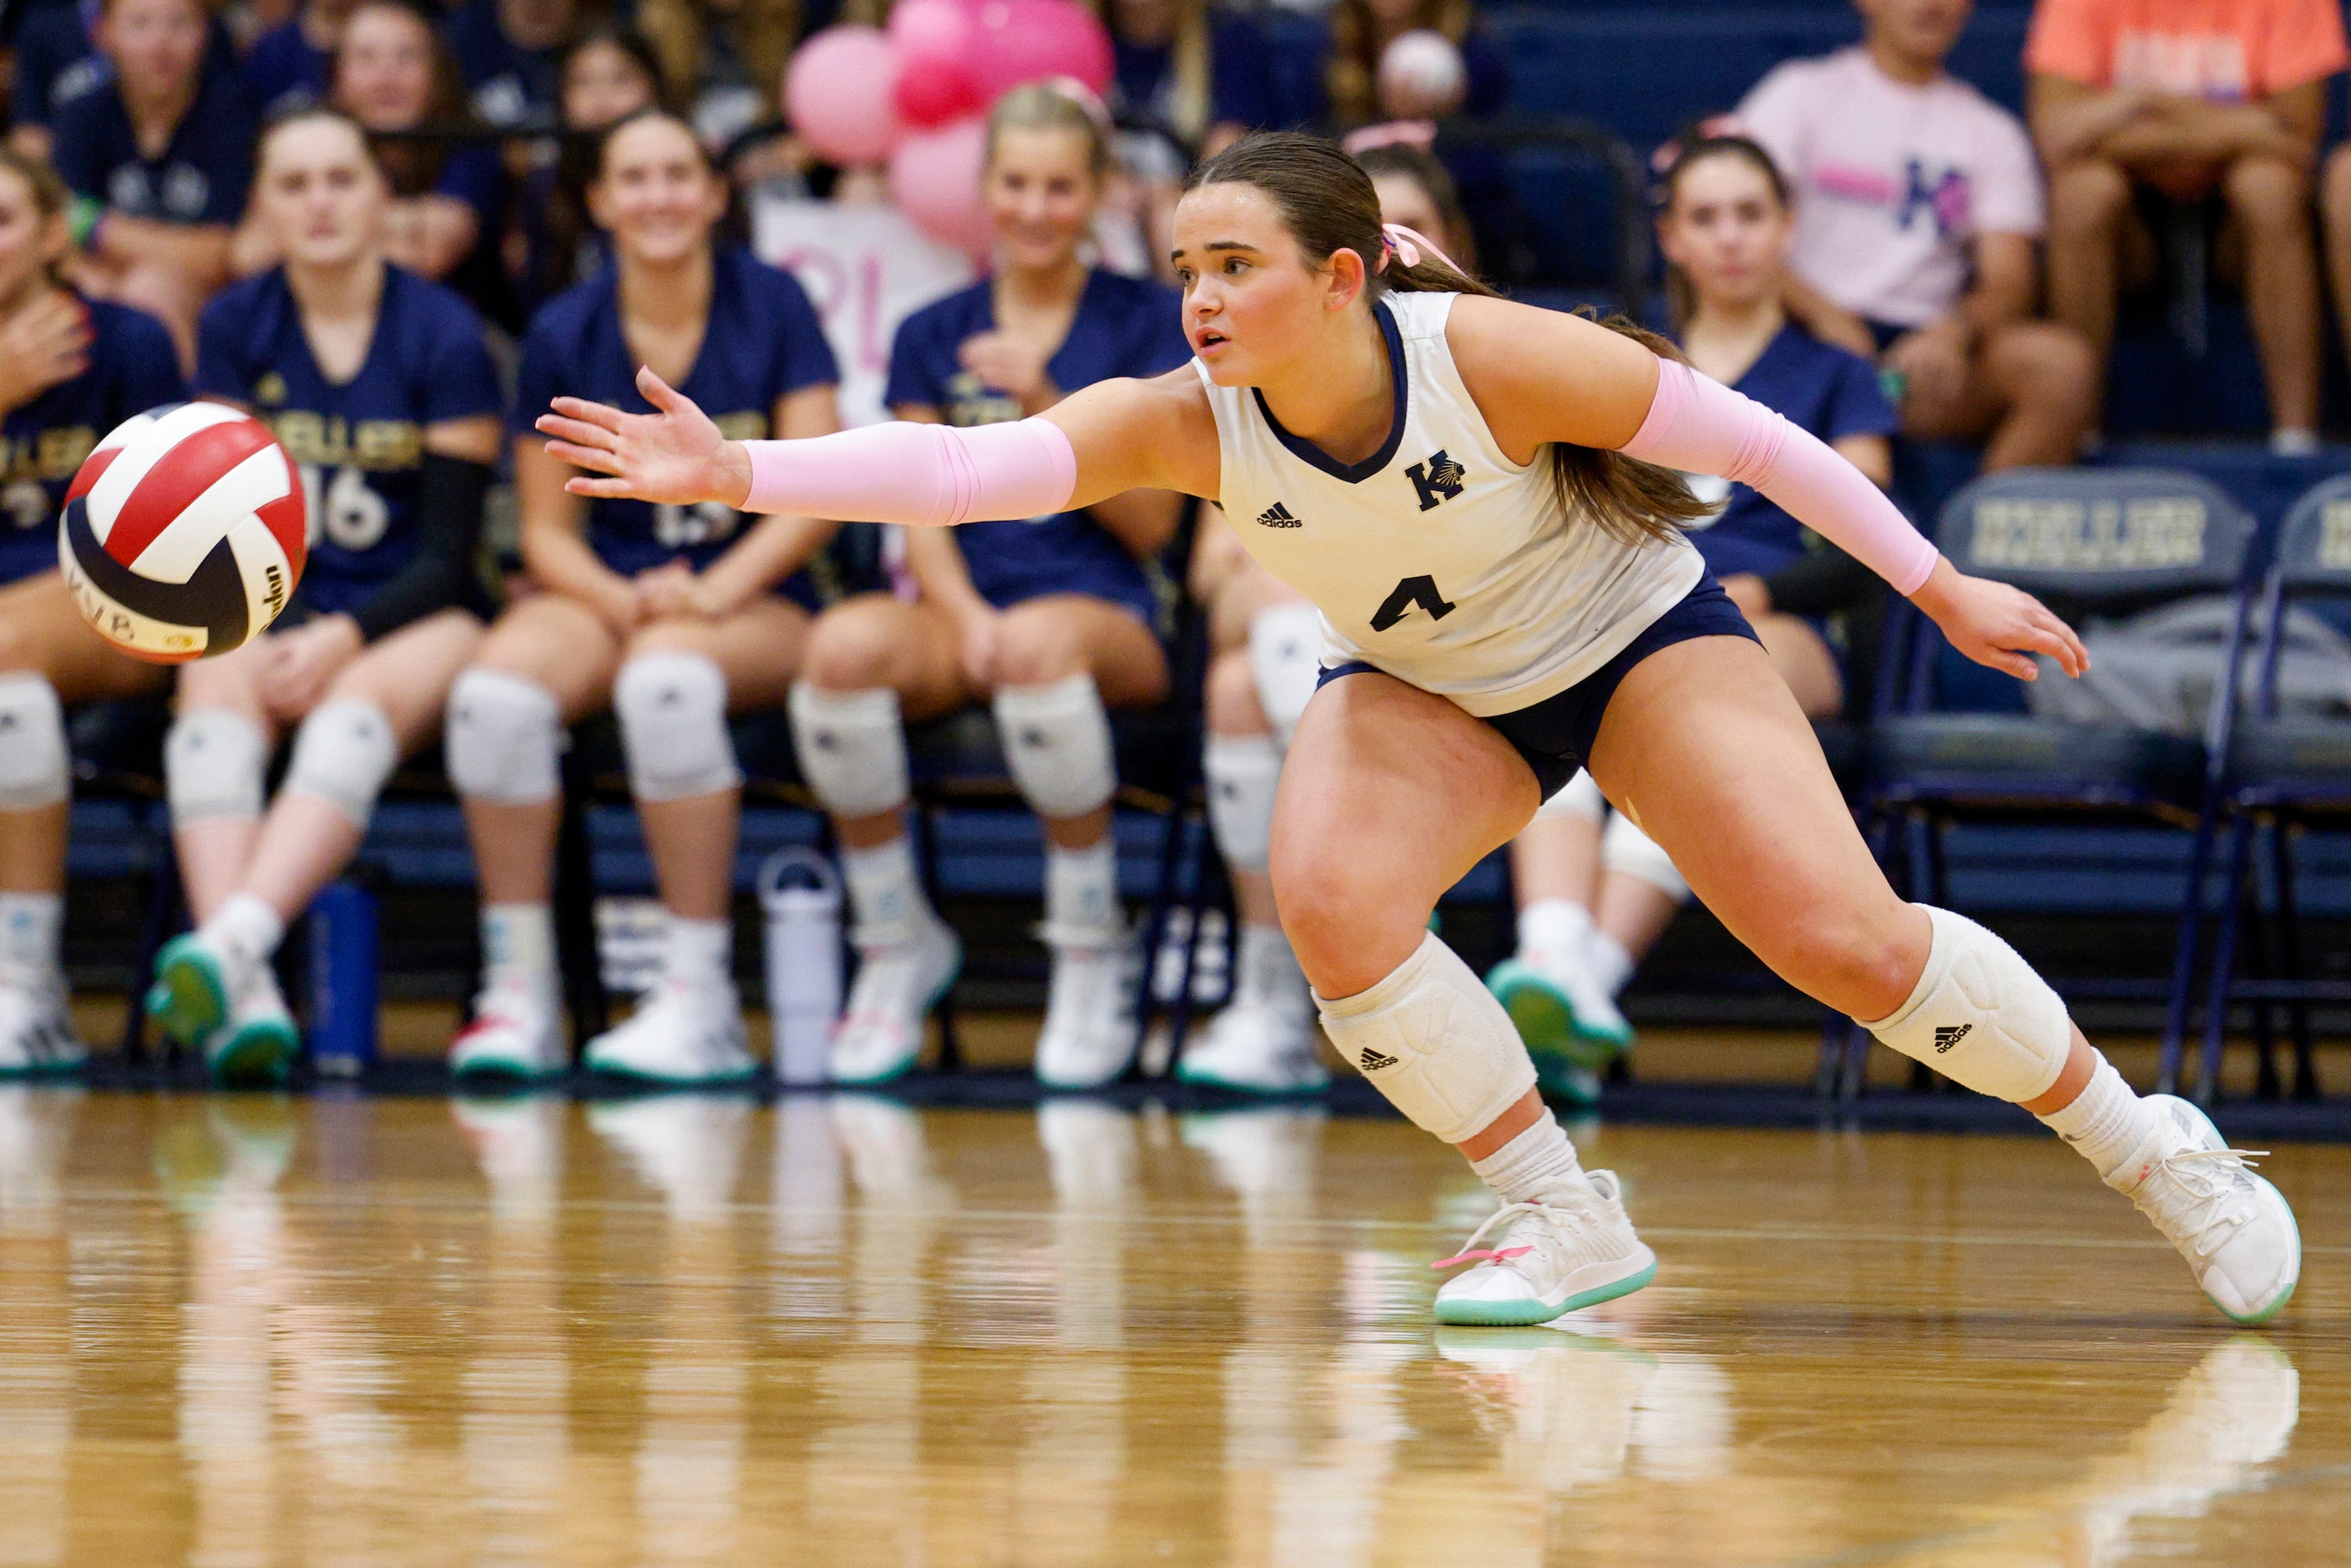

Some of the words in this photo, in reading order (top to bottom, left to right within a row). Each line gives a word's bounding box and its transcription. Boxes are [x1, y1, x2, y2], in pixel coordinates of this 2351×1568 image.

[300, 461, 391, 551] 16
[1404, 449, 1464, 512] K
[1256, 517, 1302, 529] adidas
[1970, 494, 2208, 571] KELLER
[1937, 1023, 1972, 1054] adidas
